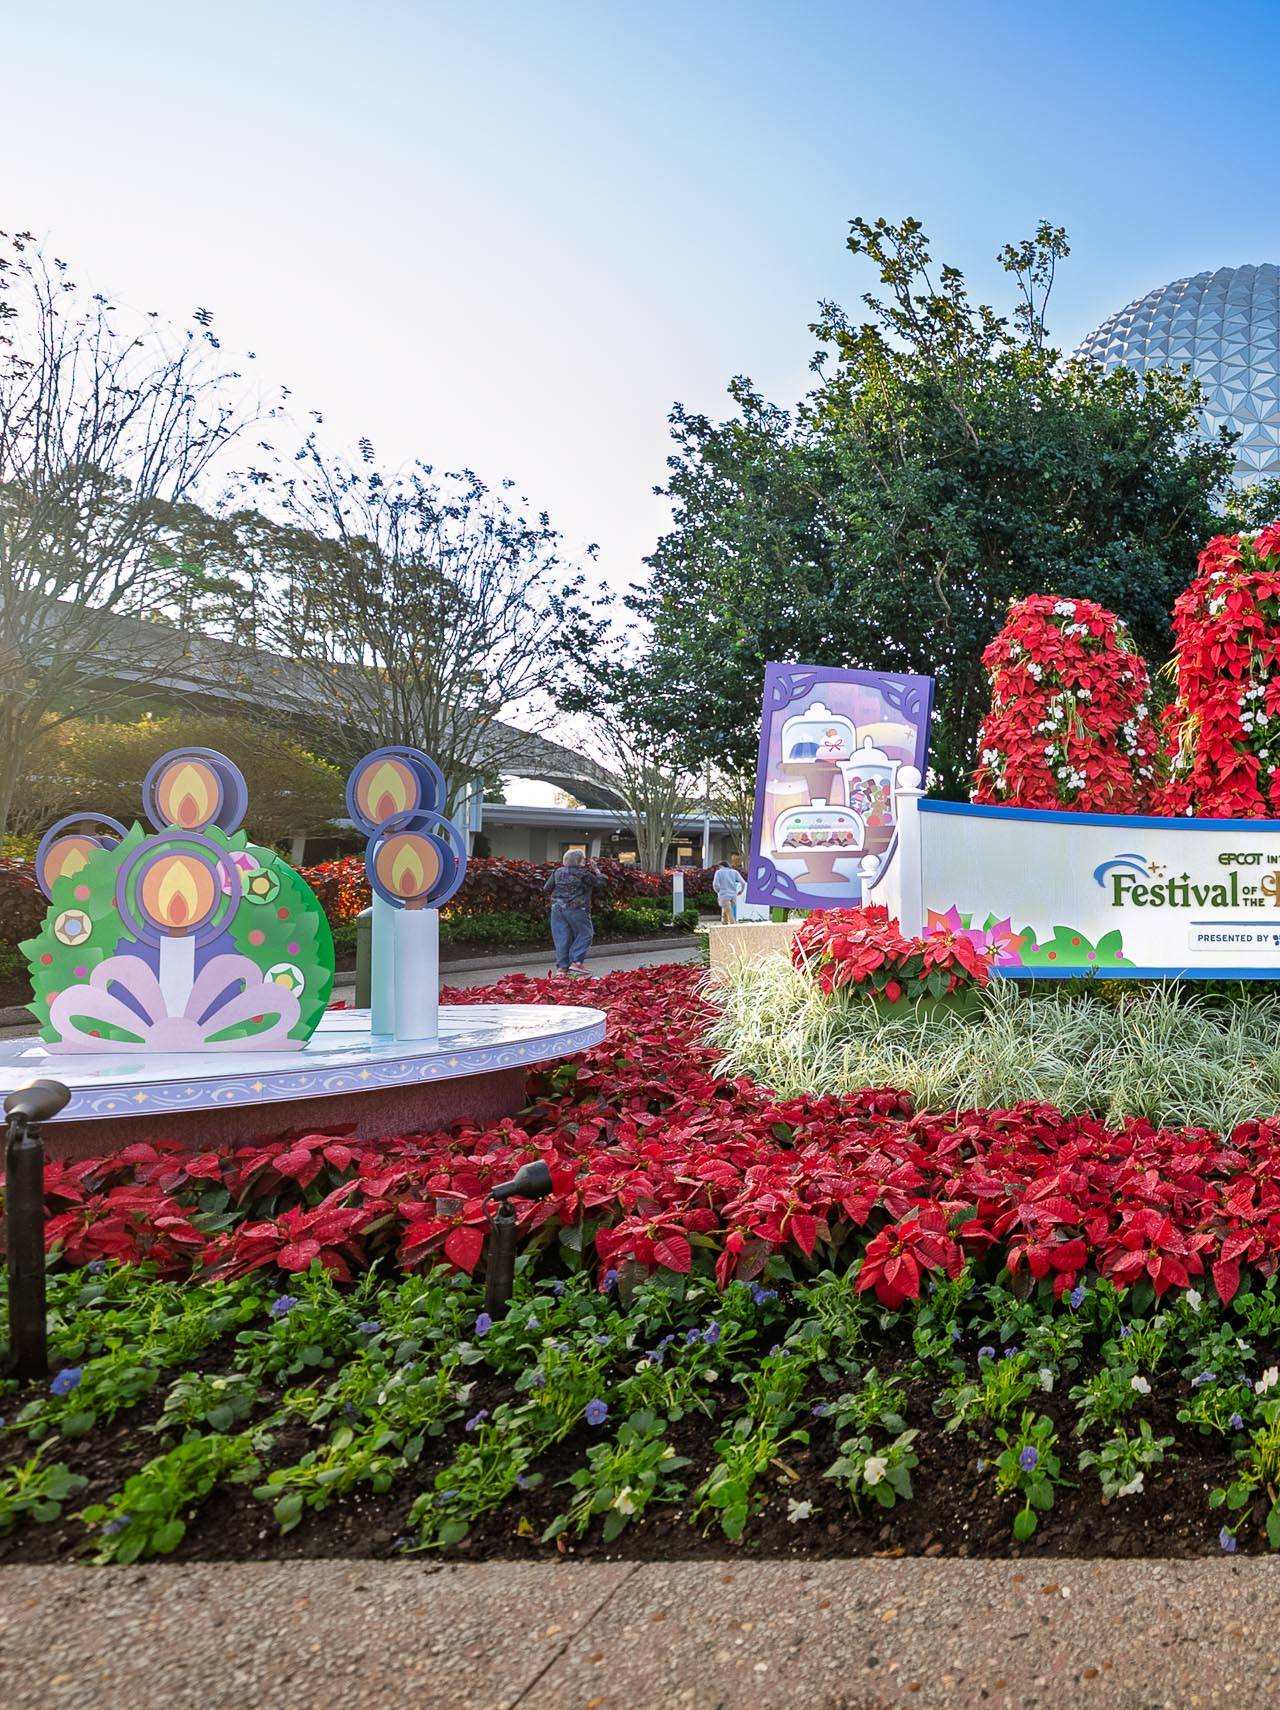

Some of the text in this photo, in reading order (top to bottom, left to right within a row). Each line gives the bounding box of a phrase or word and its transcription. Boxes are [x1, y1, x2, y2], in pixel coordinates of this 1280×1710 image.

[1218, 853, 1263, 865] EPCOT
[1111, 871, 1240, 908] Festival
[1242, 886, 1258, 896] OF
[1242, 898, 1266, 908] THE
[1197, 934, 1253, 942] PRESENTED
[1256, 934, 1269, 942] BY
